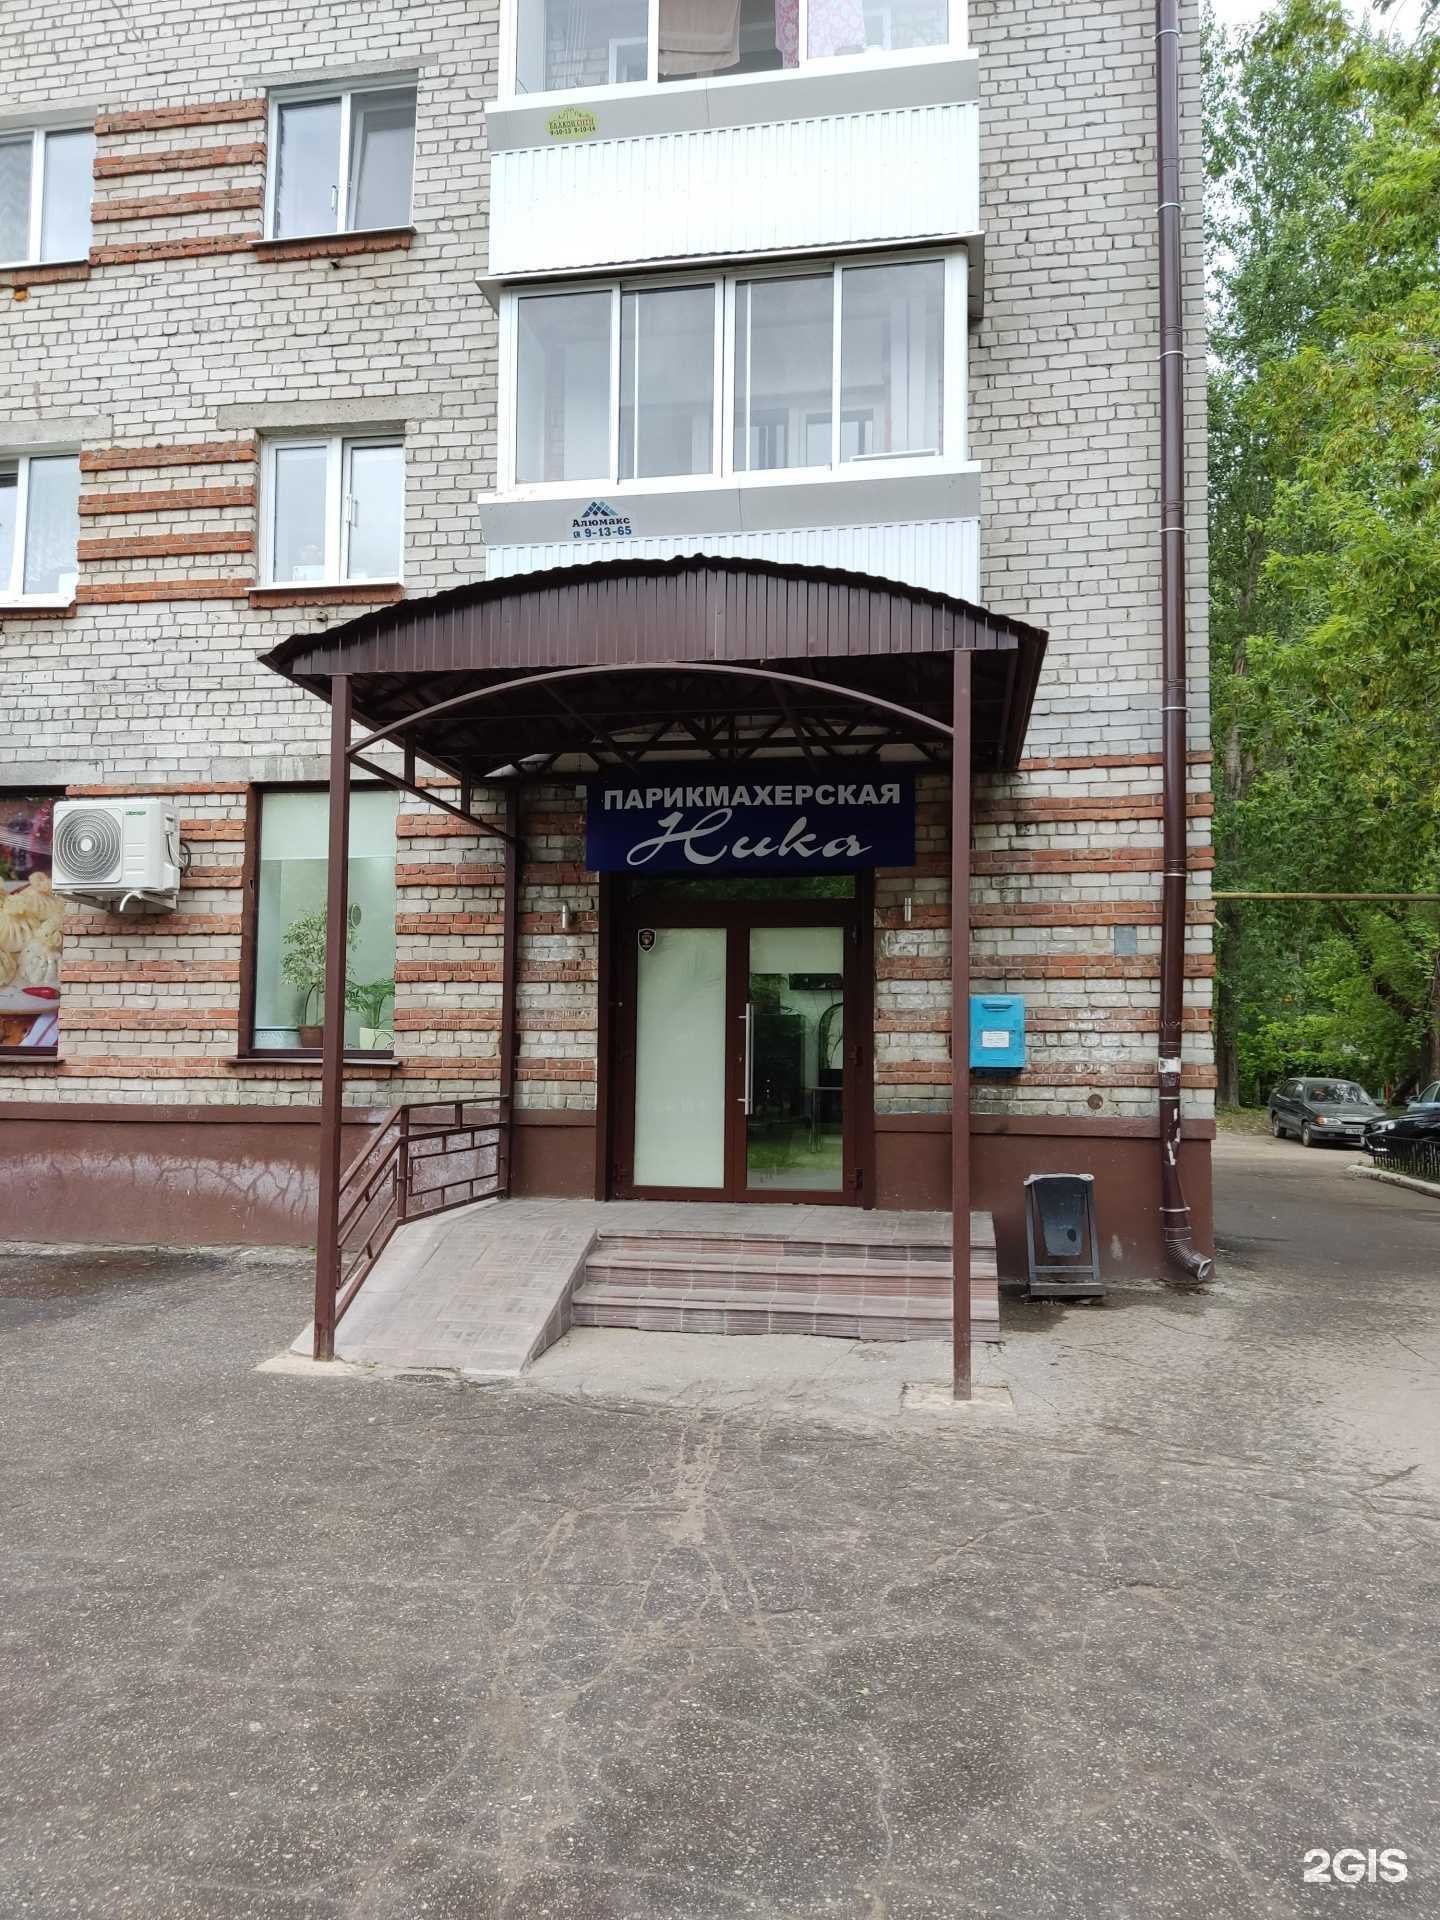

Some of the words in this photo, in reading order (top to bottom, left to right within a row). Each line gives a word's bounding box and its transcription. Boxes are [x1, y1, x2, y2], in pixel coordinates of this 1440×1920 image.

[572, 517, 631, 528] Алюмакс
[584, 525, 632, 538] 9-13-65
[603, 783, 901, 810] ПАРИКМАХЕРСКАЯ
[626, 807, 873, 866] Ника
